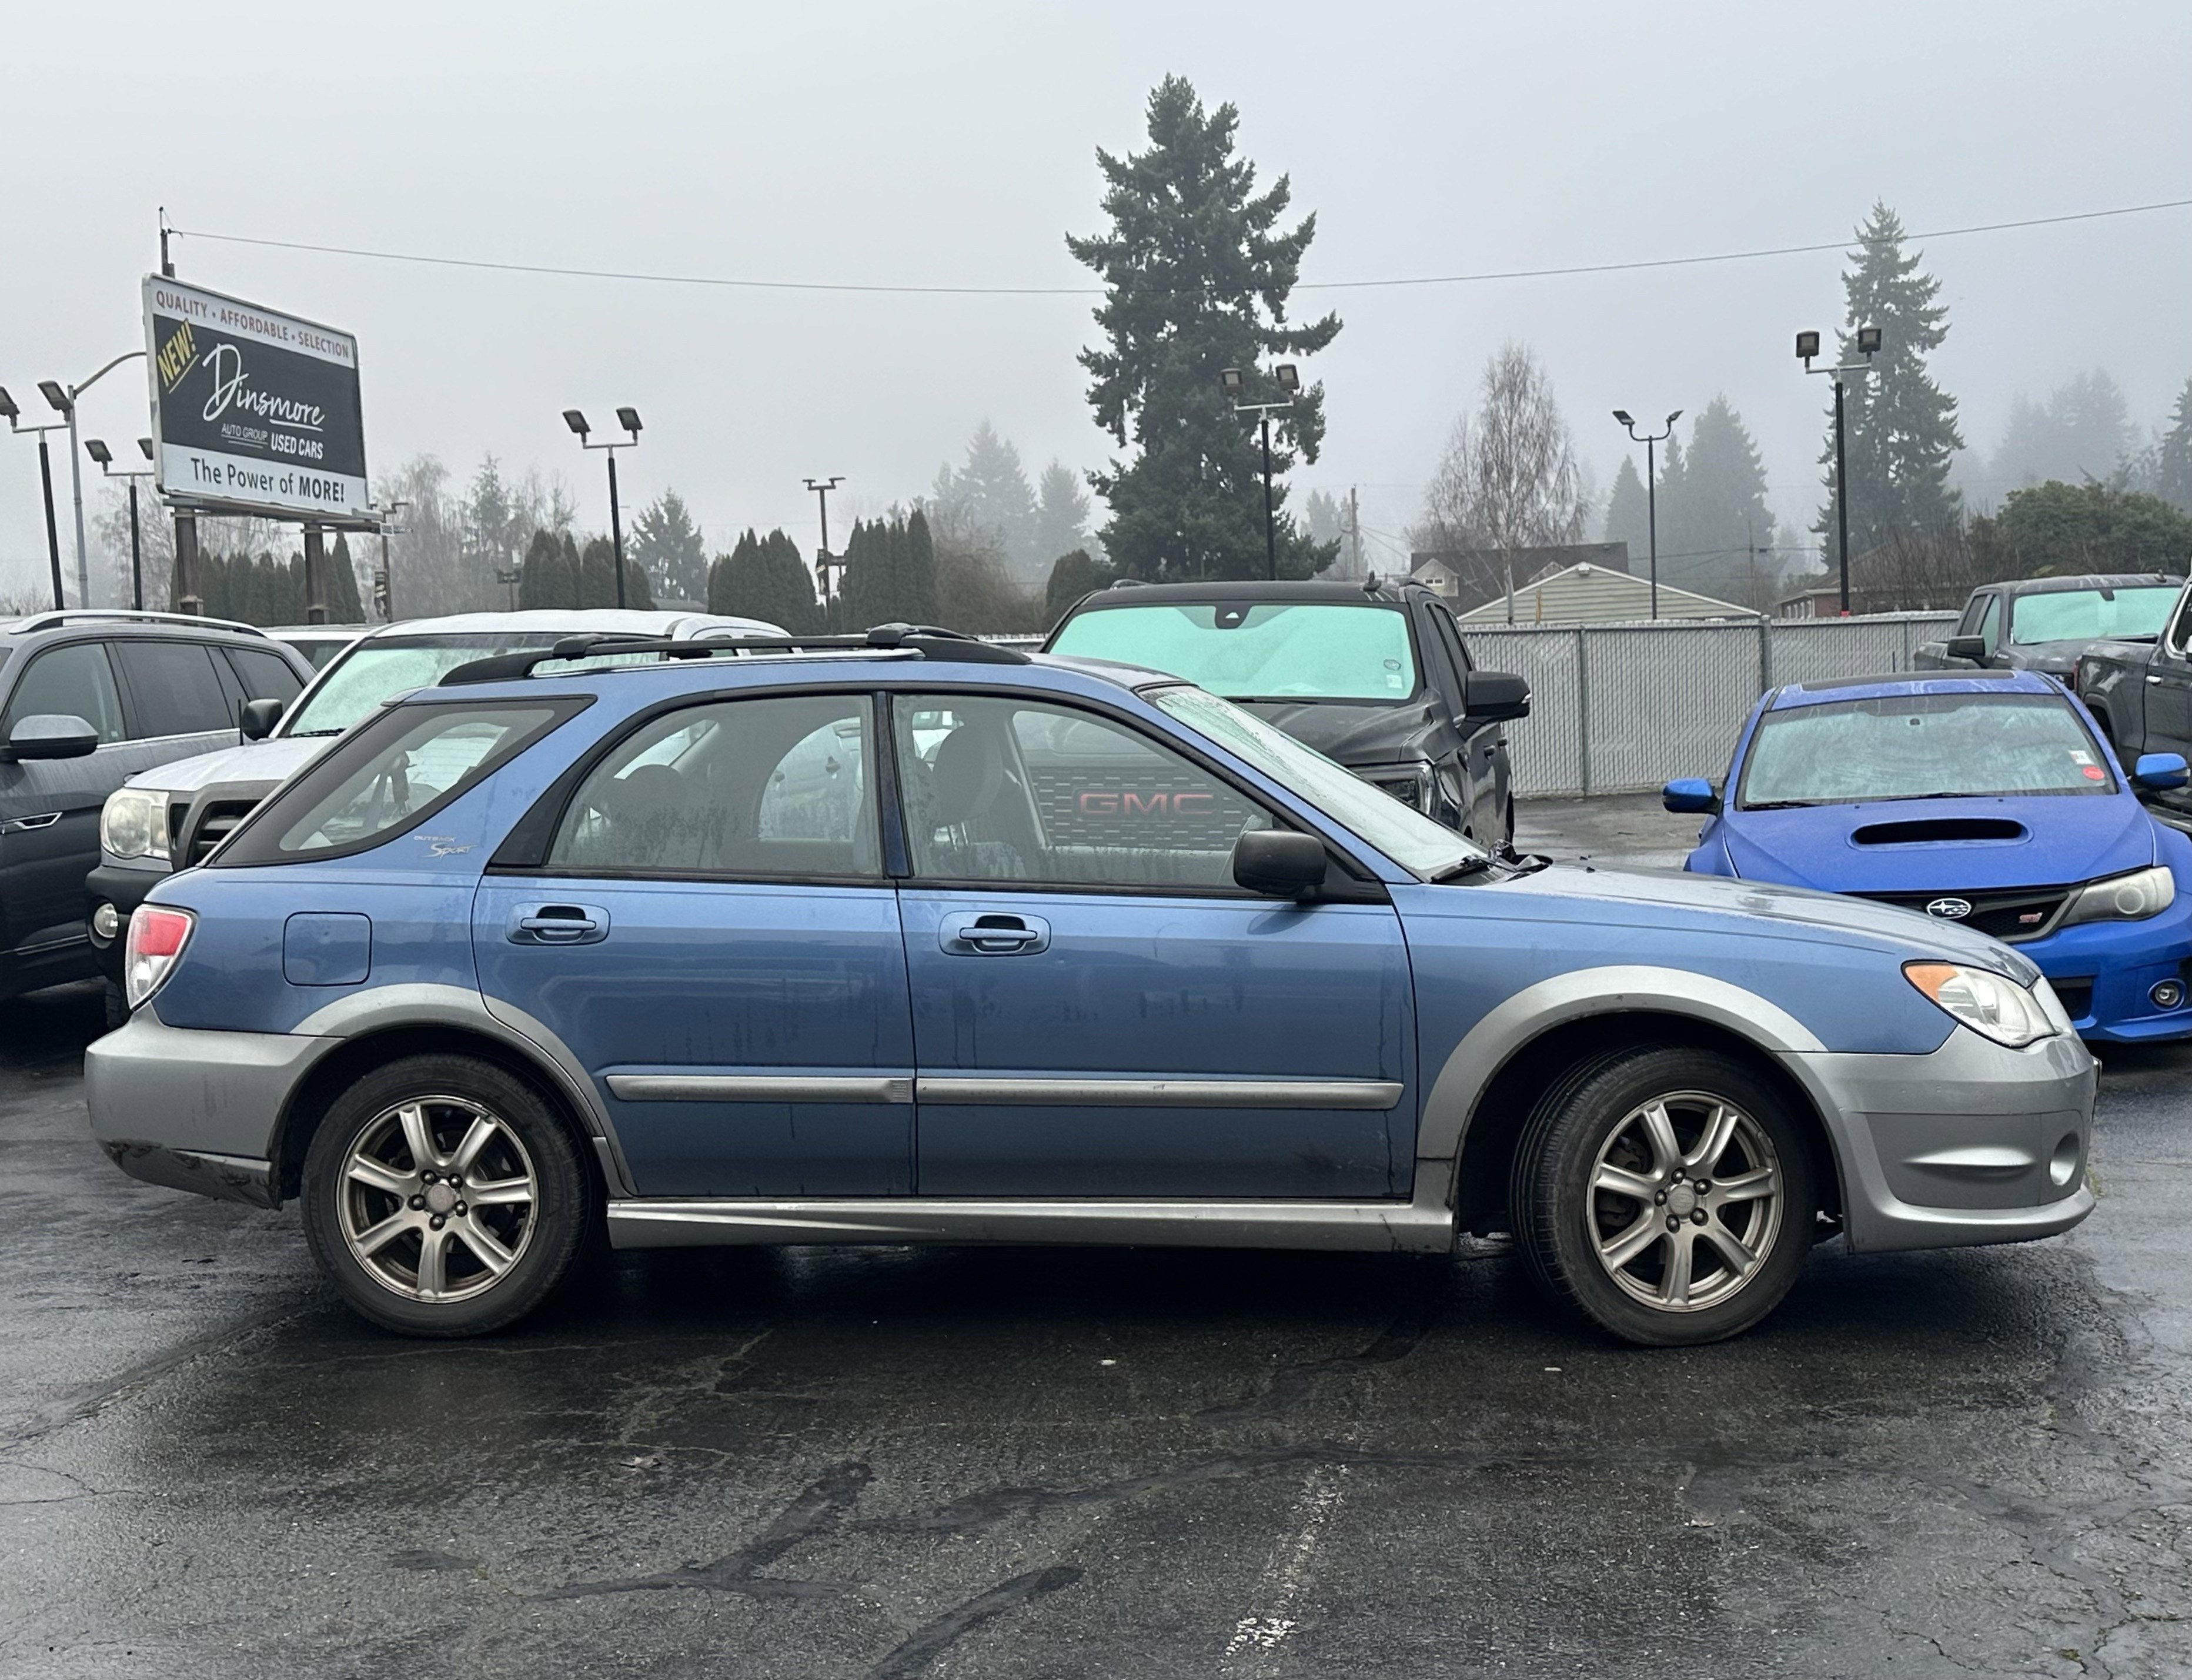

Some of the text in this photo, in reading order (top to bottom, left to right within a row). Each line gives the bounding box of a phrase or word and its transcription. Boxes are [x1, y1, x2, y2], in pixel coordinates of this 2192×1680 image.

[156, 290, 349, 359] QUALITY AFFORDABLE SELECTION
[157, 319, 196, 388] NEW!
[202, 343, 325, 425] Dinsmore
[221, 423, 323, 460] AUTO GROUP USED CARS
[191, 457, 345, 503] The Power of MORE!
[1080, 793, 1215, 815] GMC
